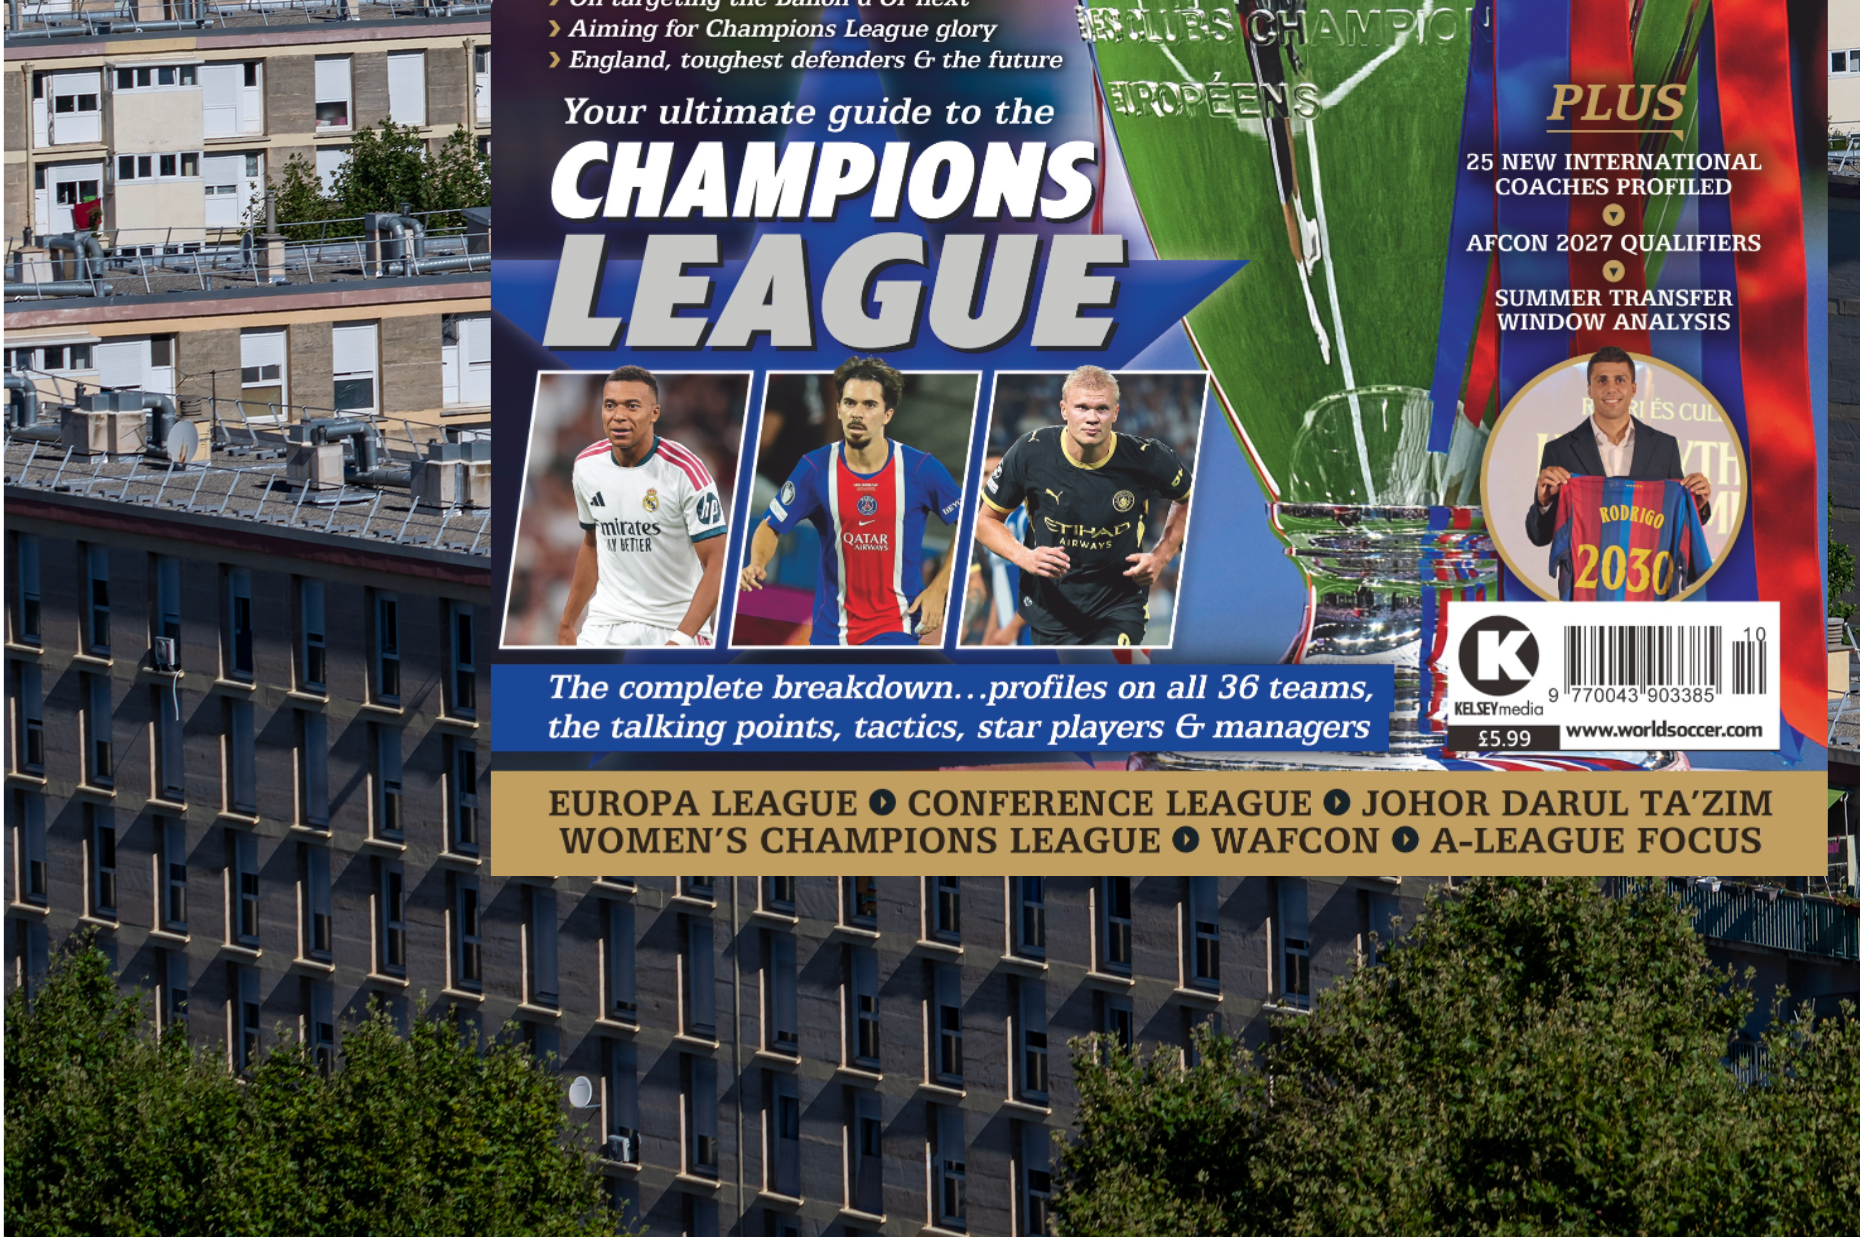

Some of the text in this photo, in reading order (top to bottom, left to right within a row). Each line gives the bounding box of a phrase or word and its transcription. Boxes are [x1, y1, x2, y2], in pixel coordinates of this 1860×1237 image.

[1599, 504, 1665, 530] RODRIGO
[1044, 516, 1131, 539] ETIHAD
[843, 532, 889, 545] QATAR
[854, 543, 889, 552] AIRWAYS
[1059, 536, 1113, 551] AIRWAYS
[1573, 543, 1674, 596] 2030
